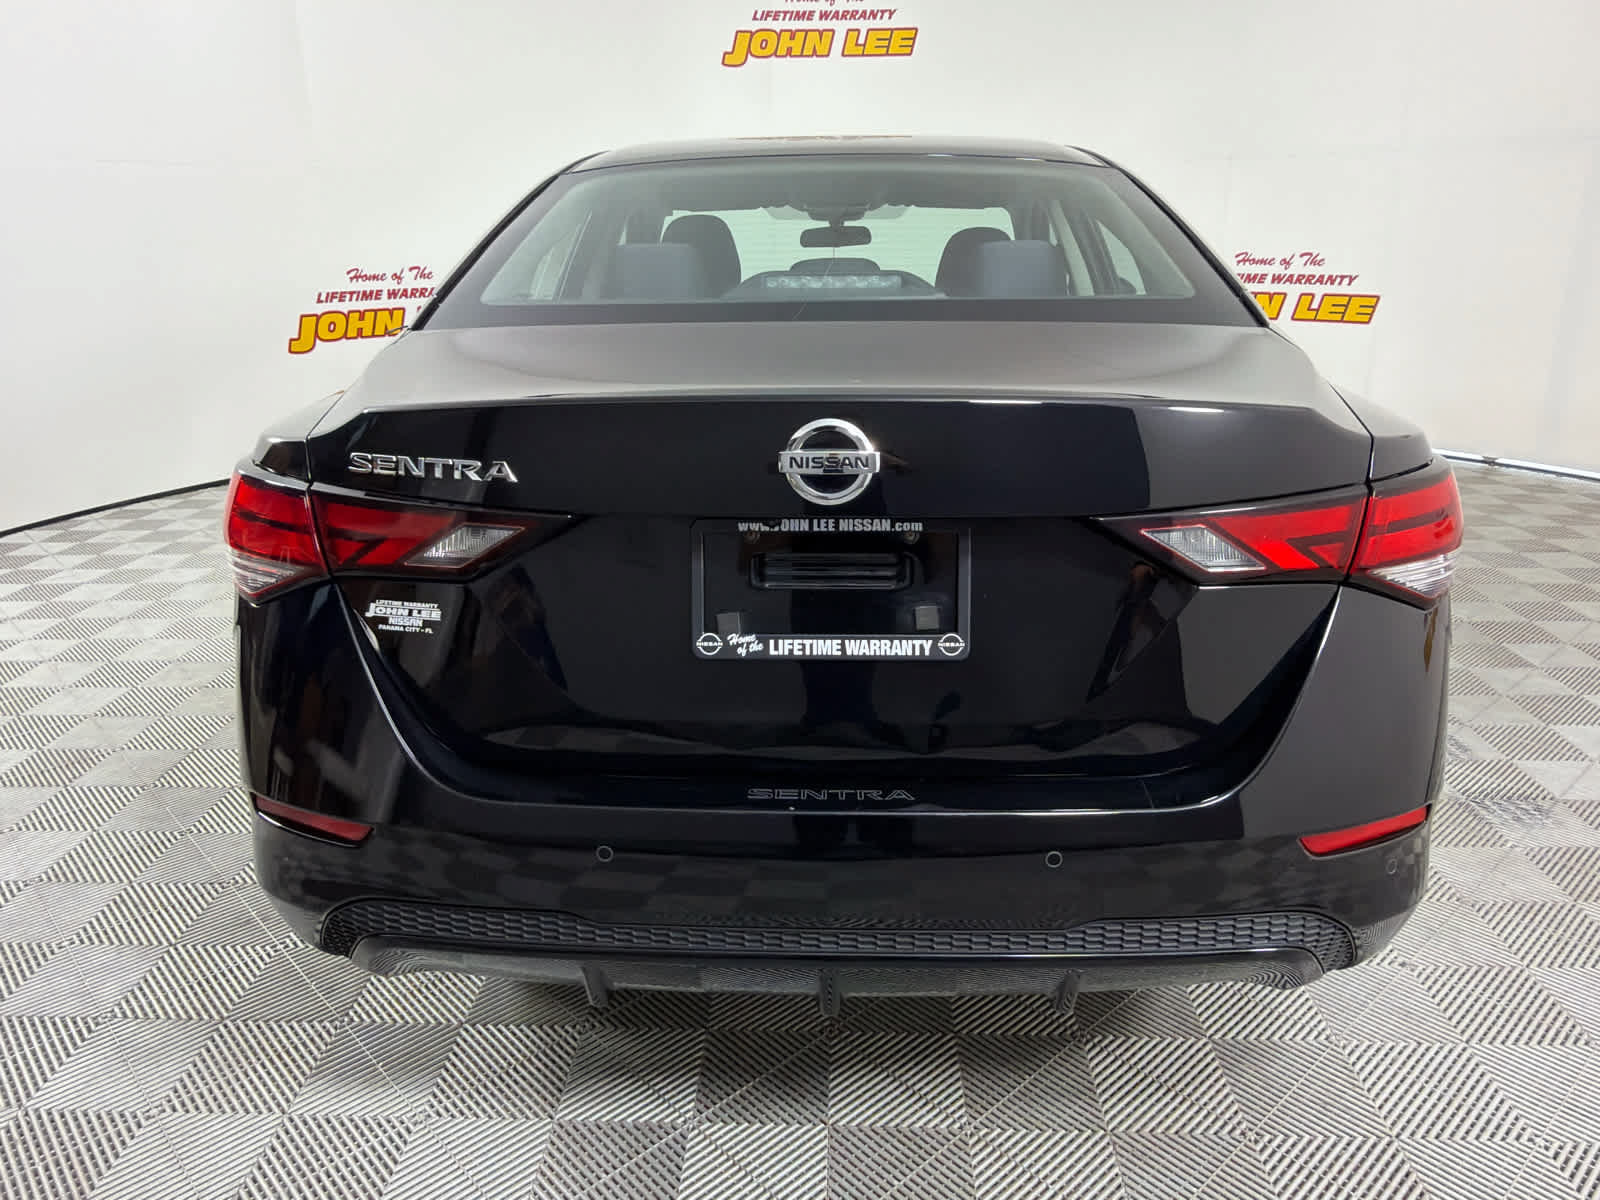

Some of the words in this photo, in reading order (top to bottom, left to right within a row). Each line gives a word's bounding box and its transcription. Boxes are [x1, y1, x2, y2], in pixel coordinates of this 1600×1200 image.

[752, 10, 815, 21] LIFETIME
[819, 9, 896, 21] WARRANTY
[722, 28, 835, 67] JOHN
[841, 28, 918, 57] LEE
[1235, 251, 1275, 267] Home
[1279, 252, 1295, 271] of
[1299, 252, 1326, 267] The
[346, 267, 388, 283] Home
[391, 266, 405, 285] of
[408, 265, 433, 281] The
[1271, 274, 1359, 287] WARRANTY
[316, 289, 383, 304] LIFETIME
[1291, 293, 1381, 325] LEE
[288, 307, 406, 354] JOHN
[348, 452, 518, 483] SENTRA
[789, 456, 870, 469] NISSAN
[813, 519, 836, 532] LEE
[839, 519, 923, 532] NISSAN.com
[365, 603, 409, 617] JOHN
[412, 608, 441, 619] LEE
[388, 617, 423, 627] NISSAN
[727, 633, 757, 646] Home
[737, 644, 748, 656] of
[749, 642, 764, 653] the
[769, 639, 842, 656] LIFETIME
[844, 639, 933, 656] WARRANTY
[747, 788, 916, 801] SENTRA
